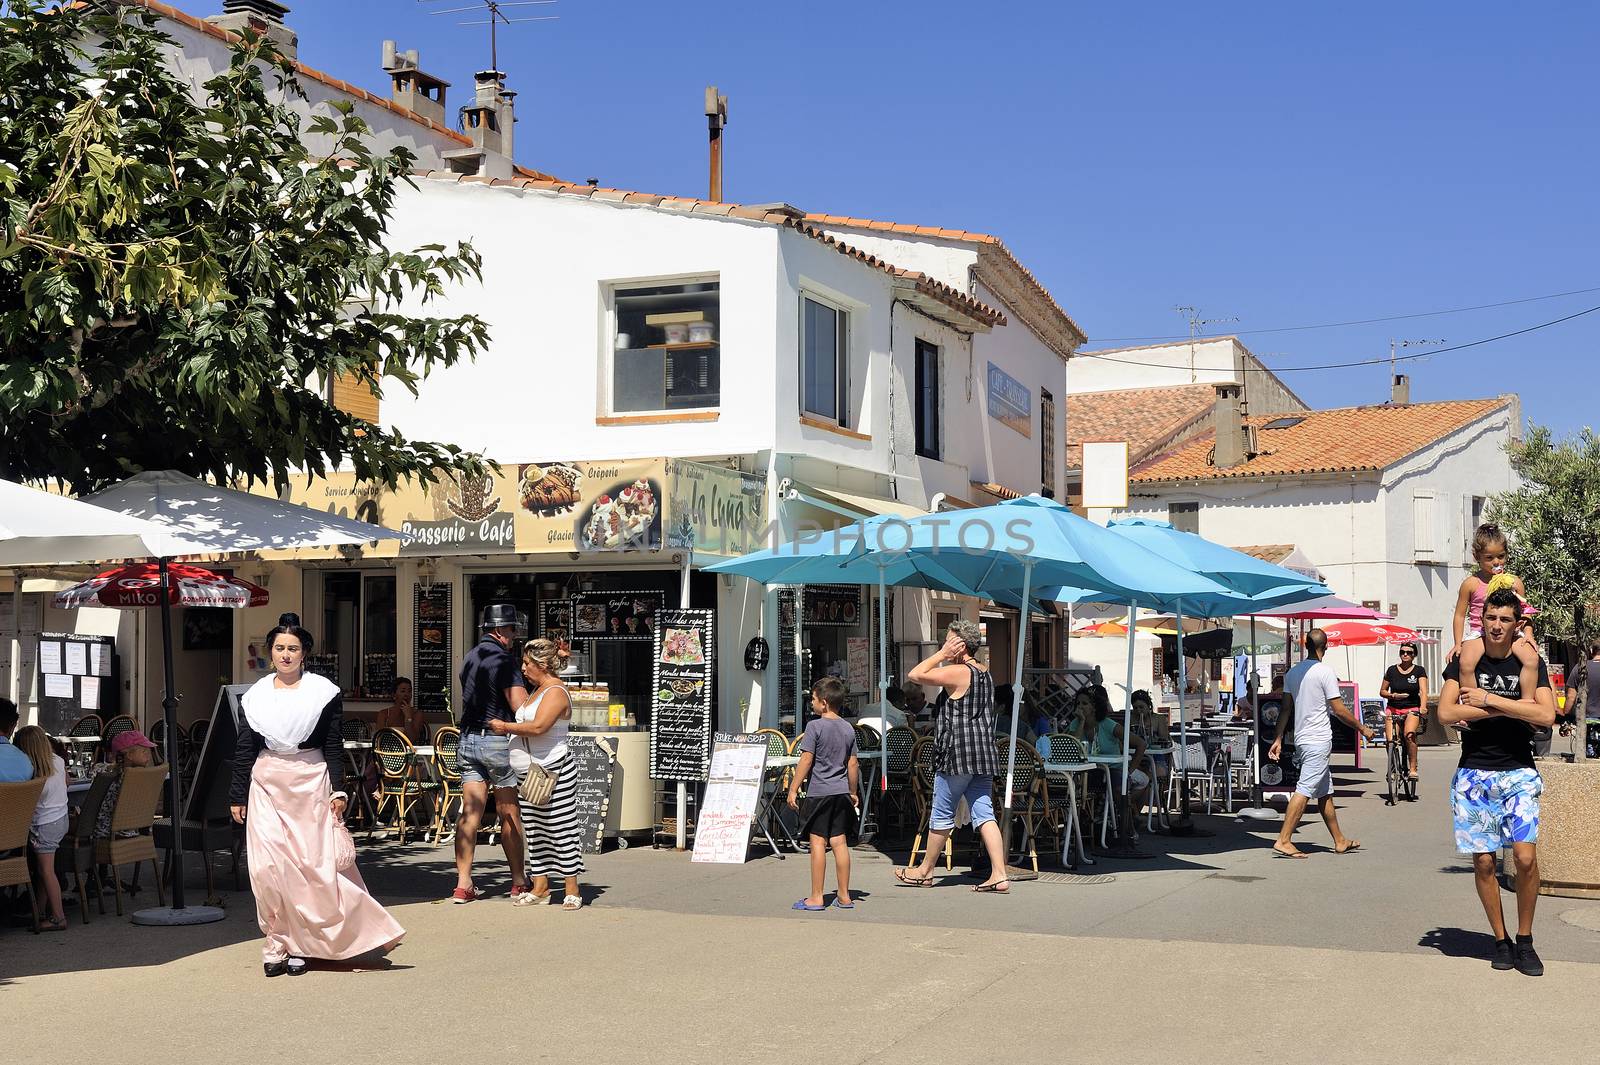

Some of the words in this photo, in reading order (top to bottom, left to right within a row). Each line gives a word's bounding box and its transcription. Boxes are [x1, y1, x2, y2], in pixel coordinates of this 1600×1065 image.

[587, 467, 619, 480] Crêperie
[324, 486, 347, 496] Service
[401, 521, 466, 547] Brasserie
[480, 518, 513, 546] Café
[119, 593, 157, 605] MIKO
[609, 597, 630, 613] Gaufres
[662, 613, 687, 625] Salades
[688, 619, 706, 633] repas
[1478, 673, 1520, 691] EA7
